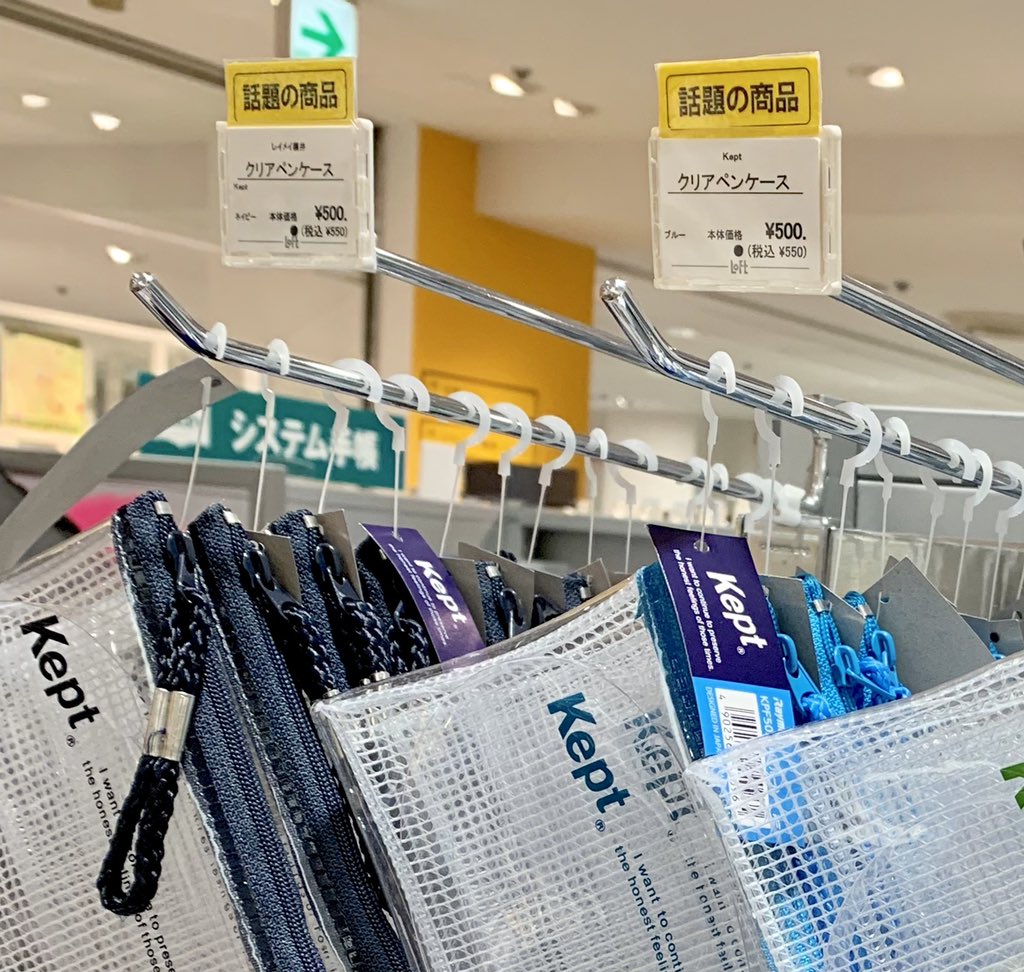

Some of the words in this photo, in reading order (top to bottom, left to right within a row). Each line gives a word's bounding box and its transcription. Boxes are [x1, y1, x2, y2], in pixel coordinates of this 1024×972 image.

[242, 81, 338, 111] 話題の商品
[678, 81, 799, 117] 話題の商品
[245, 161, 335, 178] クリアペンケース
[677, 172, 790, 191] クリアペンケース
[722, 152, 742, 162] Kept
[269, 212, 298, 222] 本体価格
[664, 229, 686, 240] ブルー
[707, 229, 743, 241] 本体価格
[747, 244, 775, 259] (税込
[778, 245, 807, 259] ¥550)
[413, 560, 468, 624] Kept
[706, 570, 768, 650] Kept
[19, 614, 101, 730] Kept
[546, 692, 631, 814] Kept
[82, 760, 95, 786] the
[91, 790, 113, 839] hones
[134, 912, 147, 930] of
[102, 776, 121, 818] want
[149, 912, 160, 931] to
[614, 845, 630, 872] the
[627, 875, 656, 932] honest
[638, 863, 661, 904] want
[657, 910, 668, 928] to
